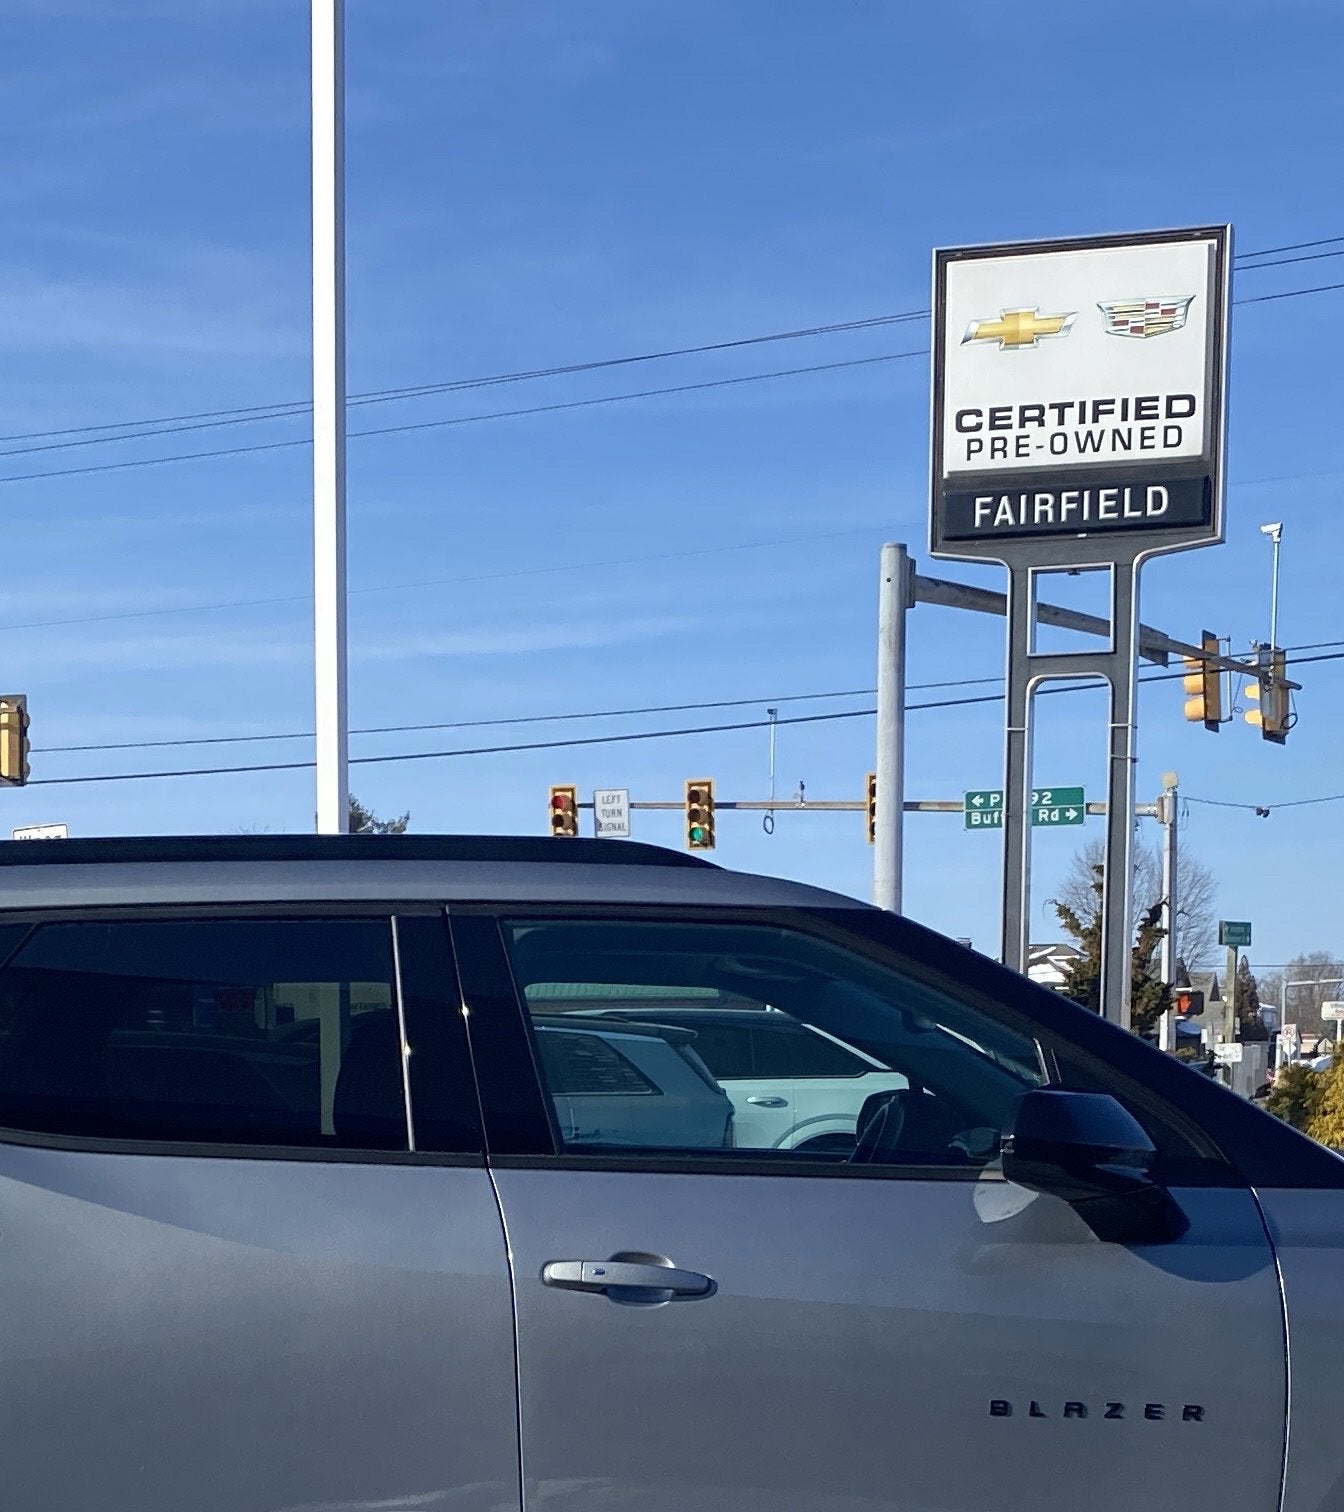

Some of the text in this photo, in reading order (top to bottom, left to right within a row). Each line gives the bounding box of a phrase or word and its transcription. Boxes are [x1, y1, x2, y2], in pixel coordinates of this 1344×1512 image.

[955, 394, 1197, 433] CERTIFIED
[966, 424, 1183, 461] PRE-OWNED
[974, 485, 1170, 528] FAIRFIELD
[601, 794, 622, 805] LEFT
[601, 808, 623, 818] TURN
[1038, 808, 1060, 822] Rd
[599, 822, 627, 832] SIGNAL
[988, 1399, 1206, 1422] BLAZER
